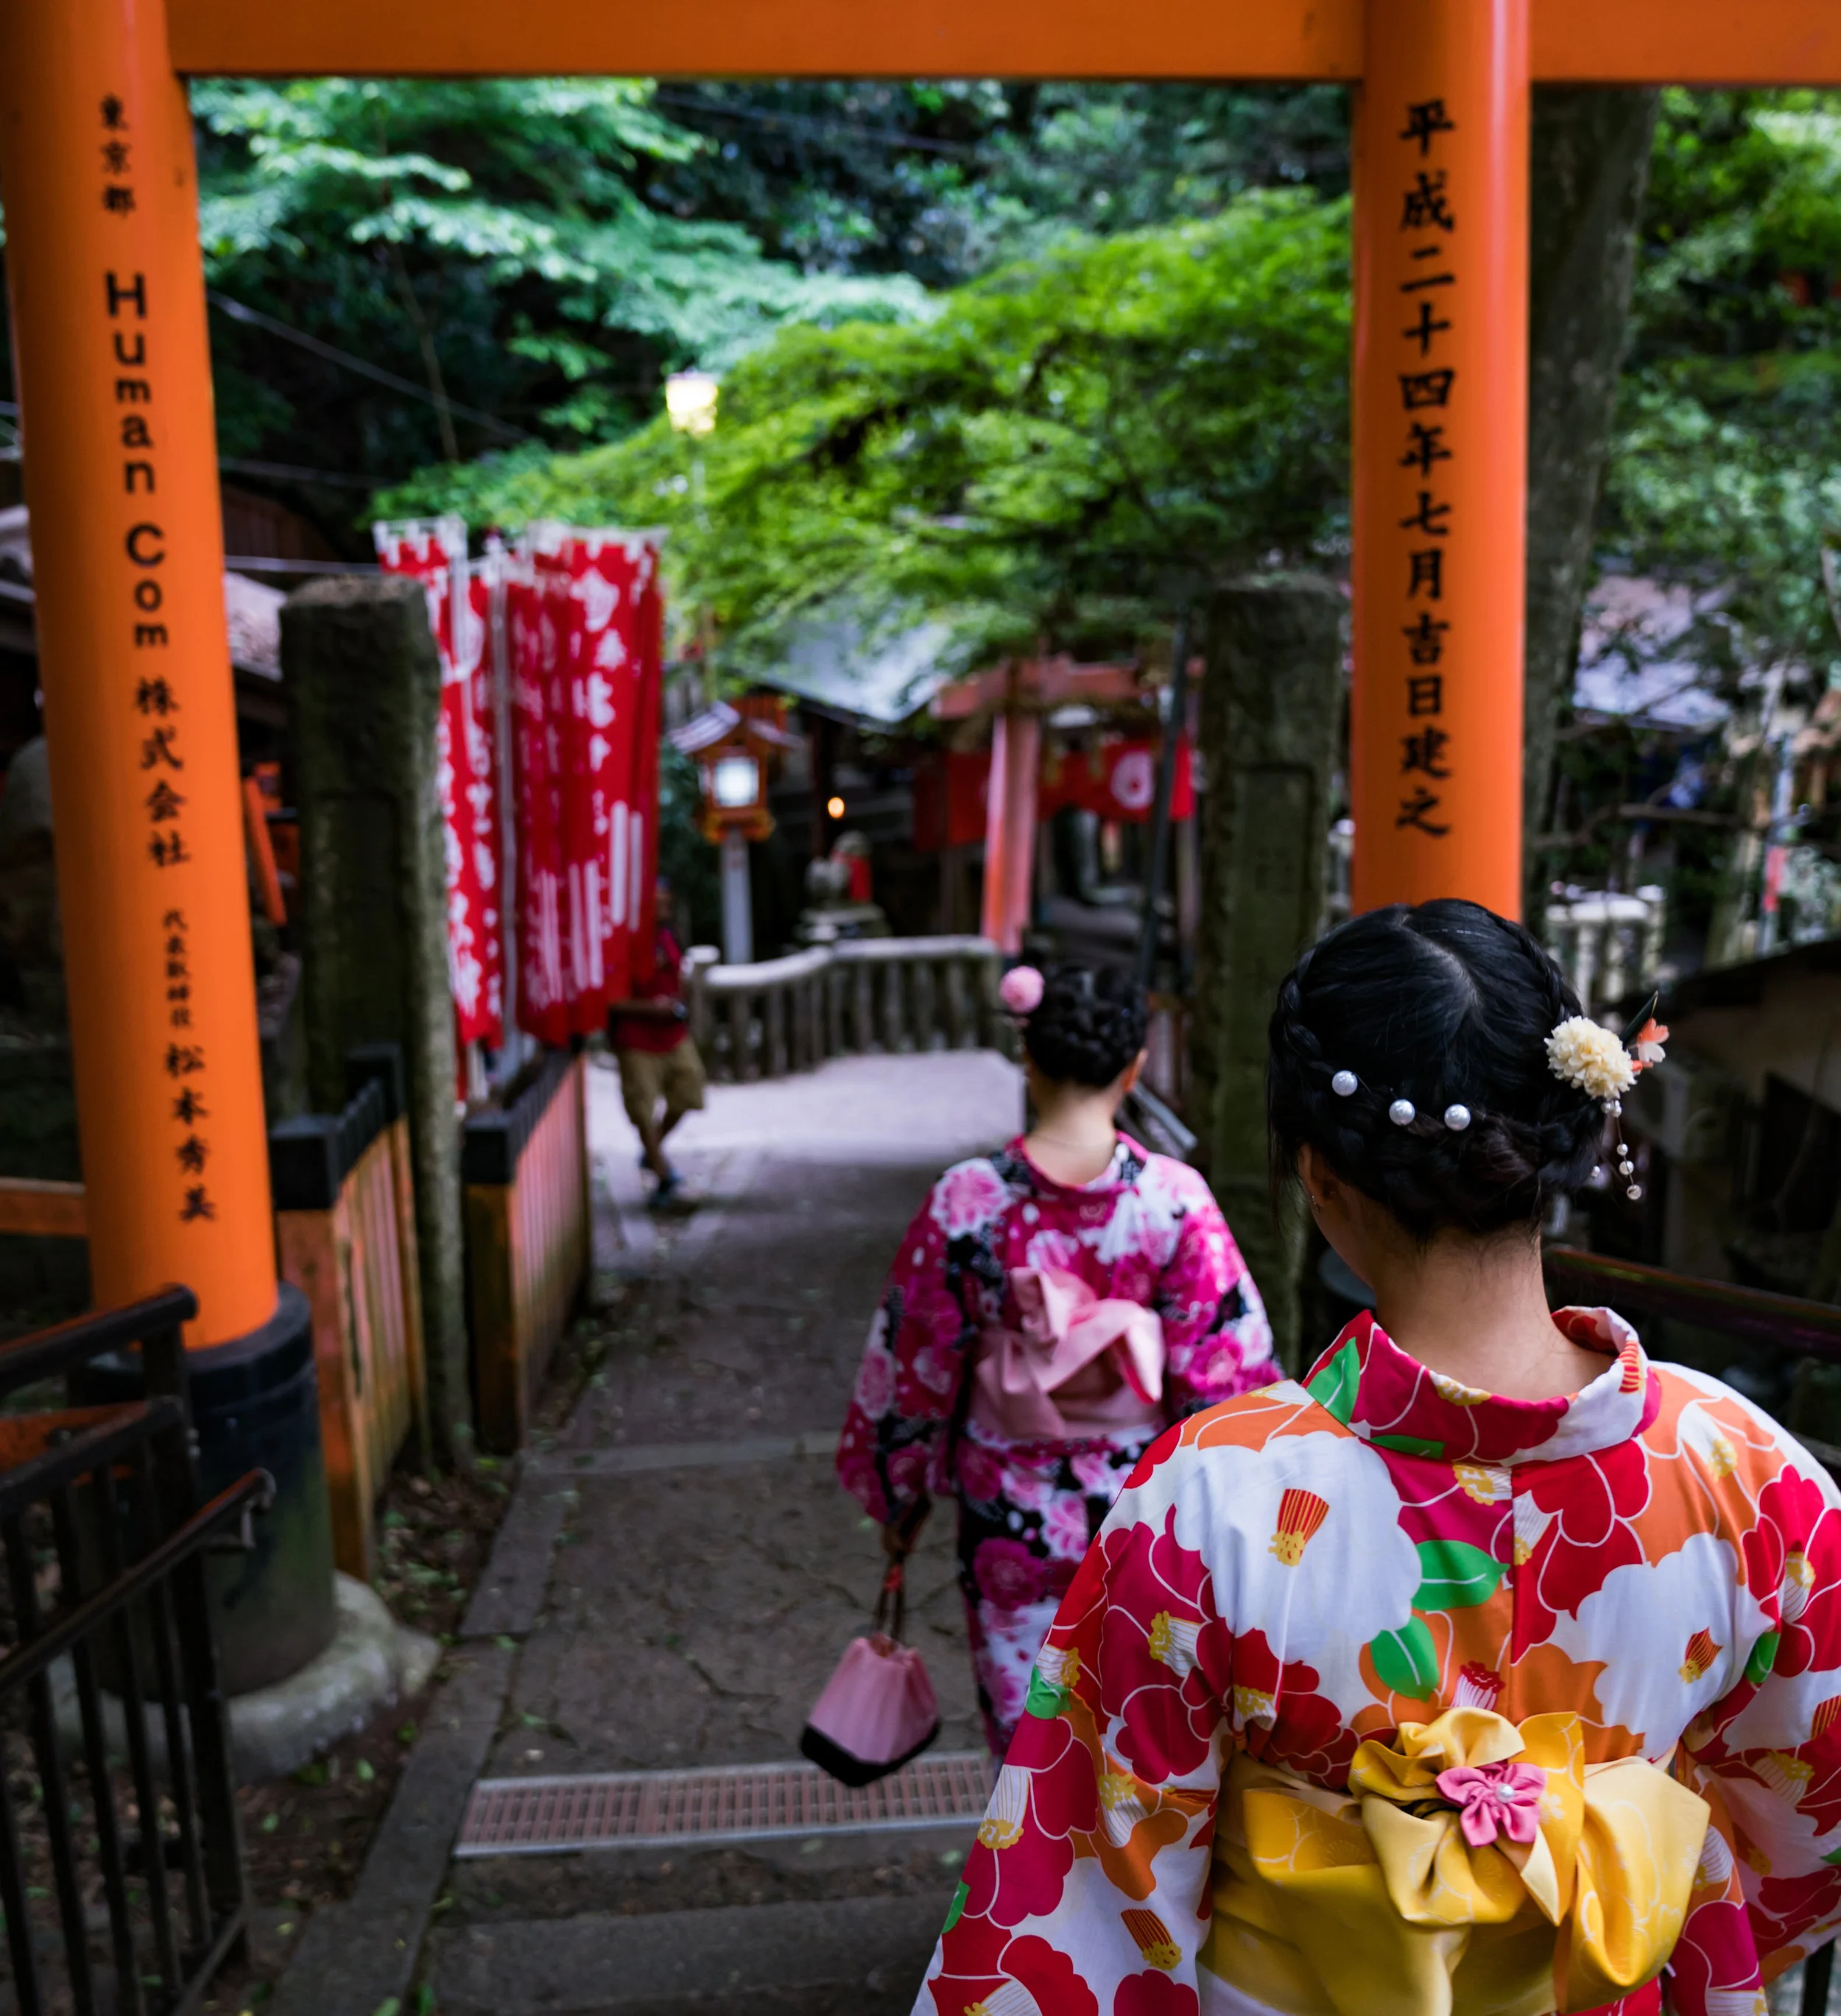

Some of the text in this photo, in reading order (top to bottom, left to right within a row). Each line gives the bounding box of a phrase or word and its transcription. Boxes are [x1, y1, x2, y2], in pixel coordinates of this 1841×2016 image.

[99, 94, 135, 216] 東京都
[106, 272, 168, 647] Human Com
[1398, 99, 1455, 838] 平成二十四年七月吉日建之
[135, 677, 191, 867] 株式会社
